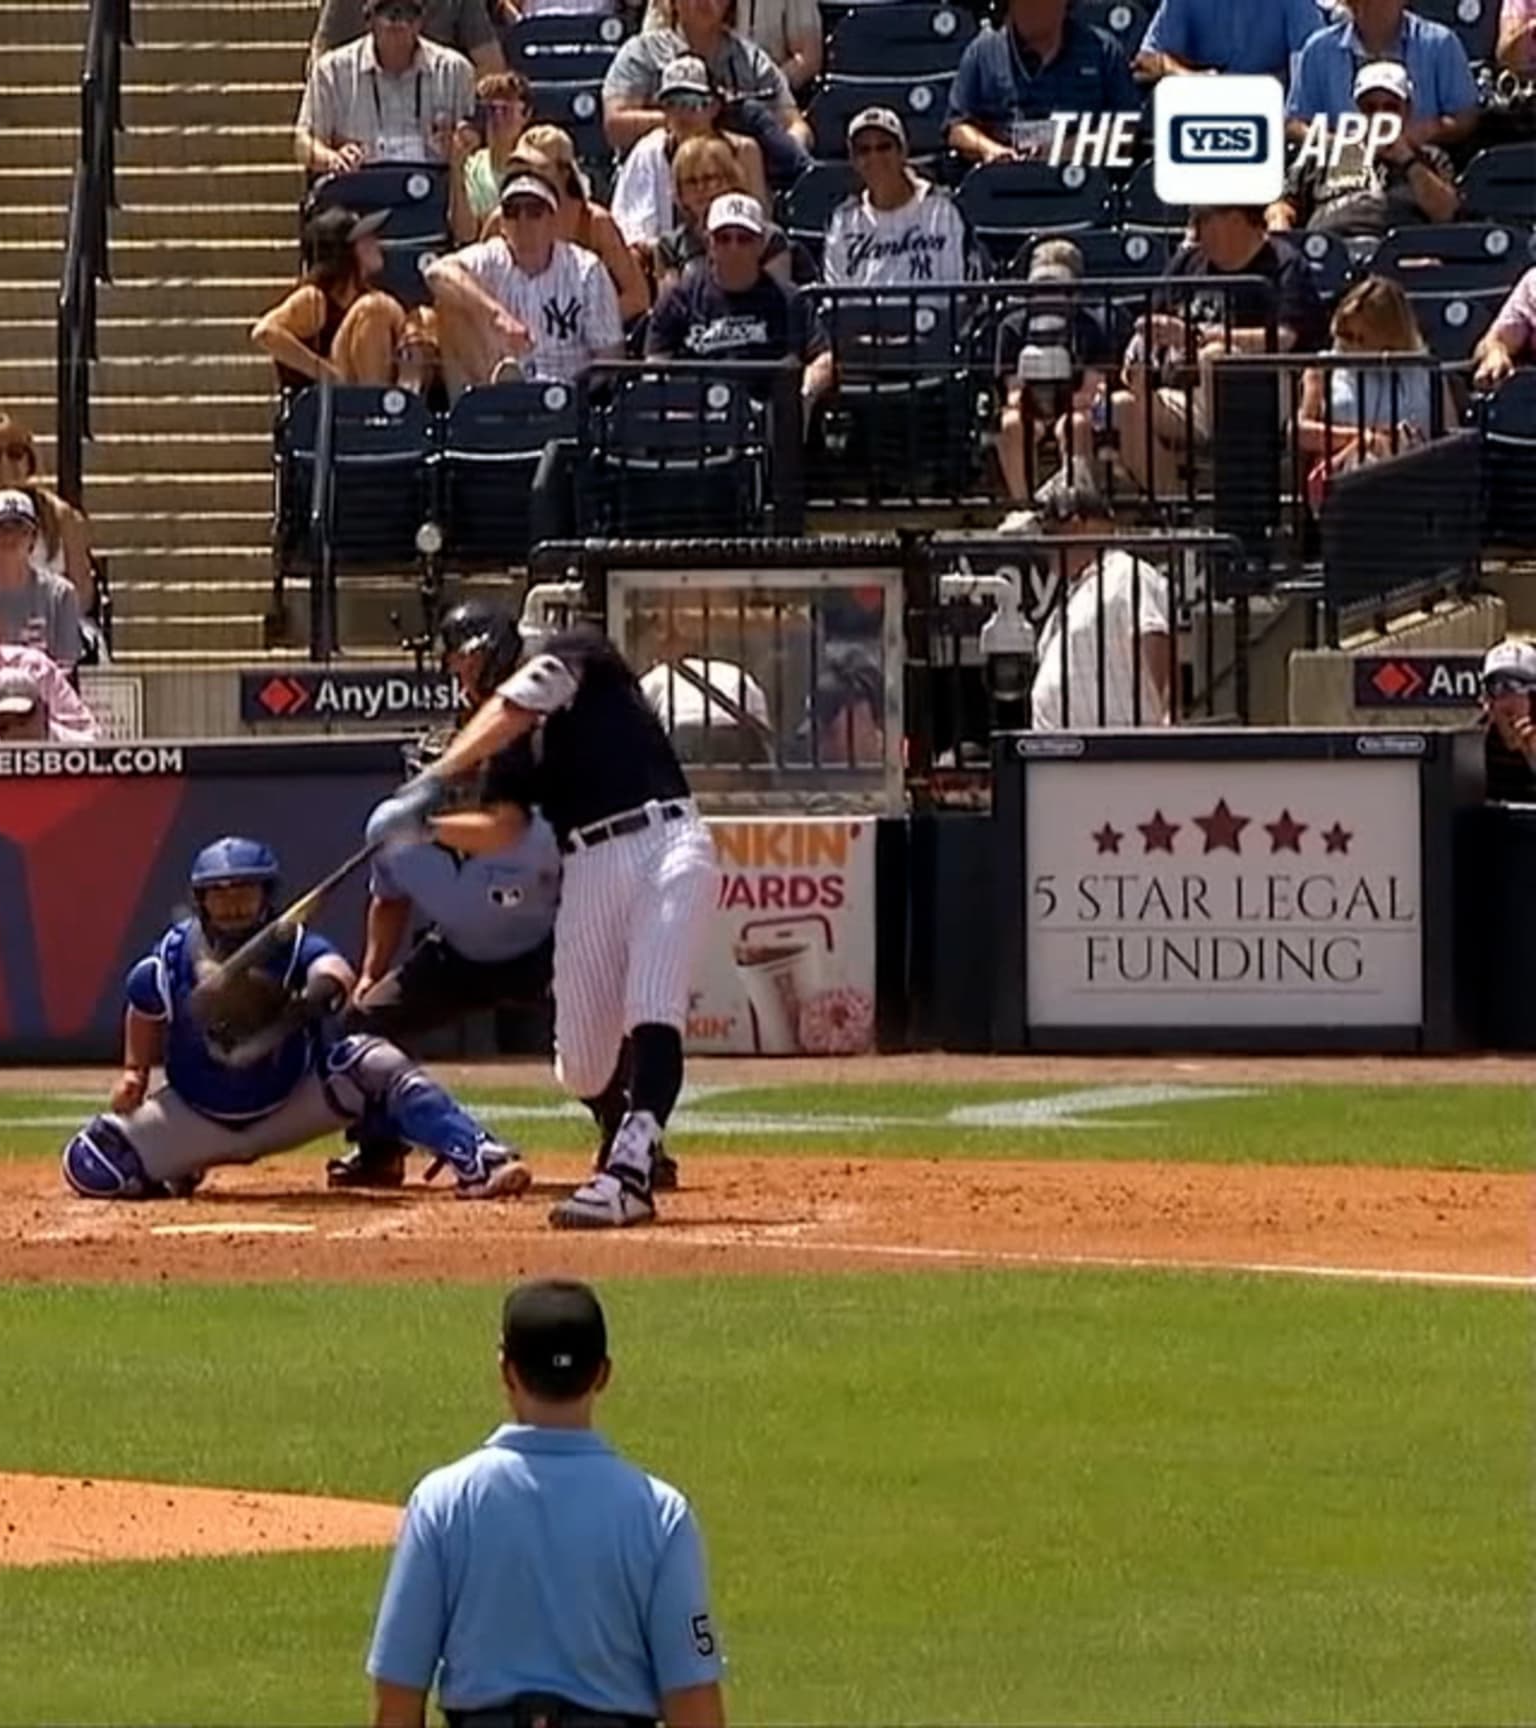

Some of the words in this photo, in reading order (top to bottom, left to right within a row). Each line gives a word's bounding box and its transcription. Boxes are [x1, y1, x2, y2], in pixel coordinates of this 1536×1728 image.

[542, 297, 582, 339] NY
[715, 822, 862, 867] NKIN'
[717, 873, 845, 910] ARDS
[1033, 875, 1058, 920] 5
[1077, 874, 1213, 921] STAR
[1236, 874, 1416, 921] LEGAL
[1086, 935, 1364, 983] FUNDING
[691, 1614, 715, 1657] 5
